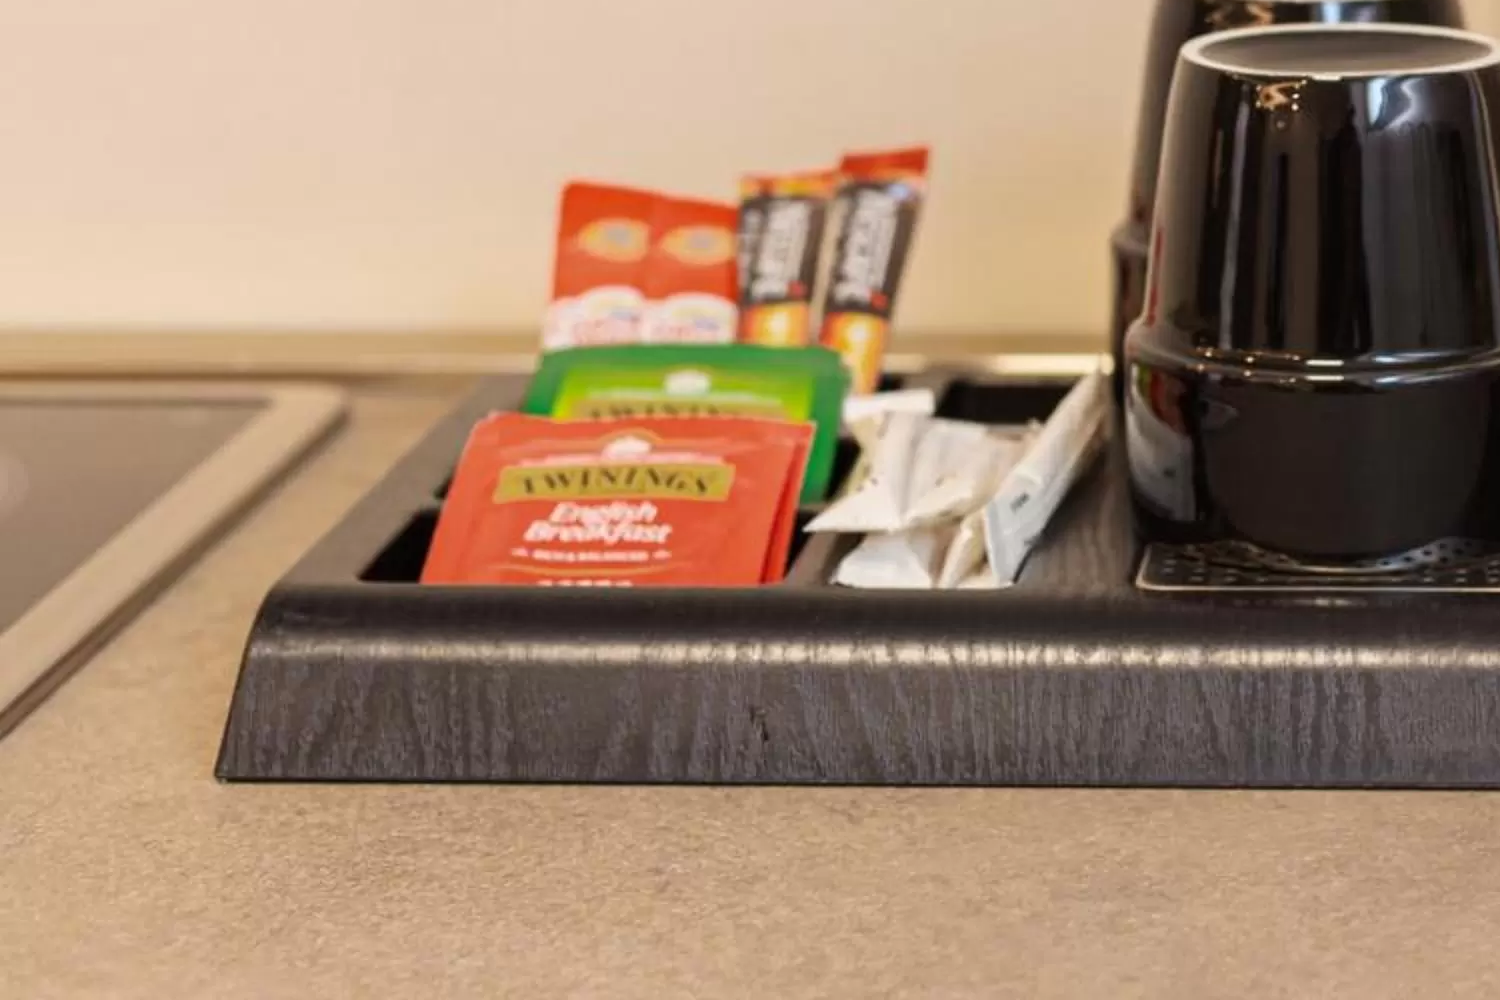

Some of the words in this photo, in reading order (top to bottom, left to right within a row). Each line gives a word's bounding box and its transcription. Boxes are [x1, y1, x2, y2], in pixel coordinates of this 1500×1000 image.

[523, 466, 709, 494] TWININGS
[549, 501, 659, 525] English
[523, 518, 673, 544] Breakfast
